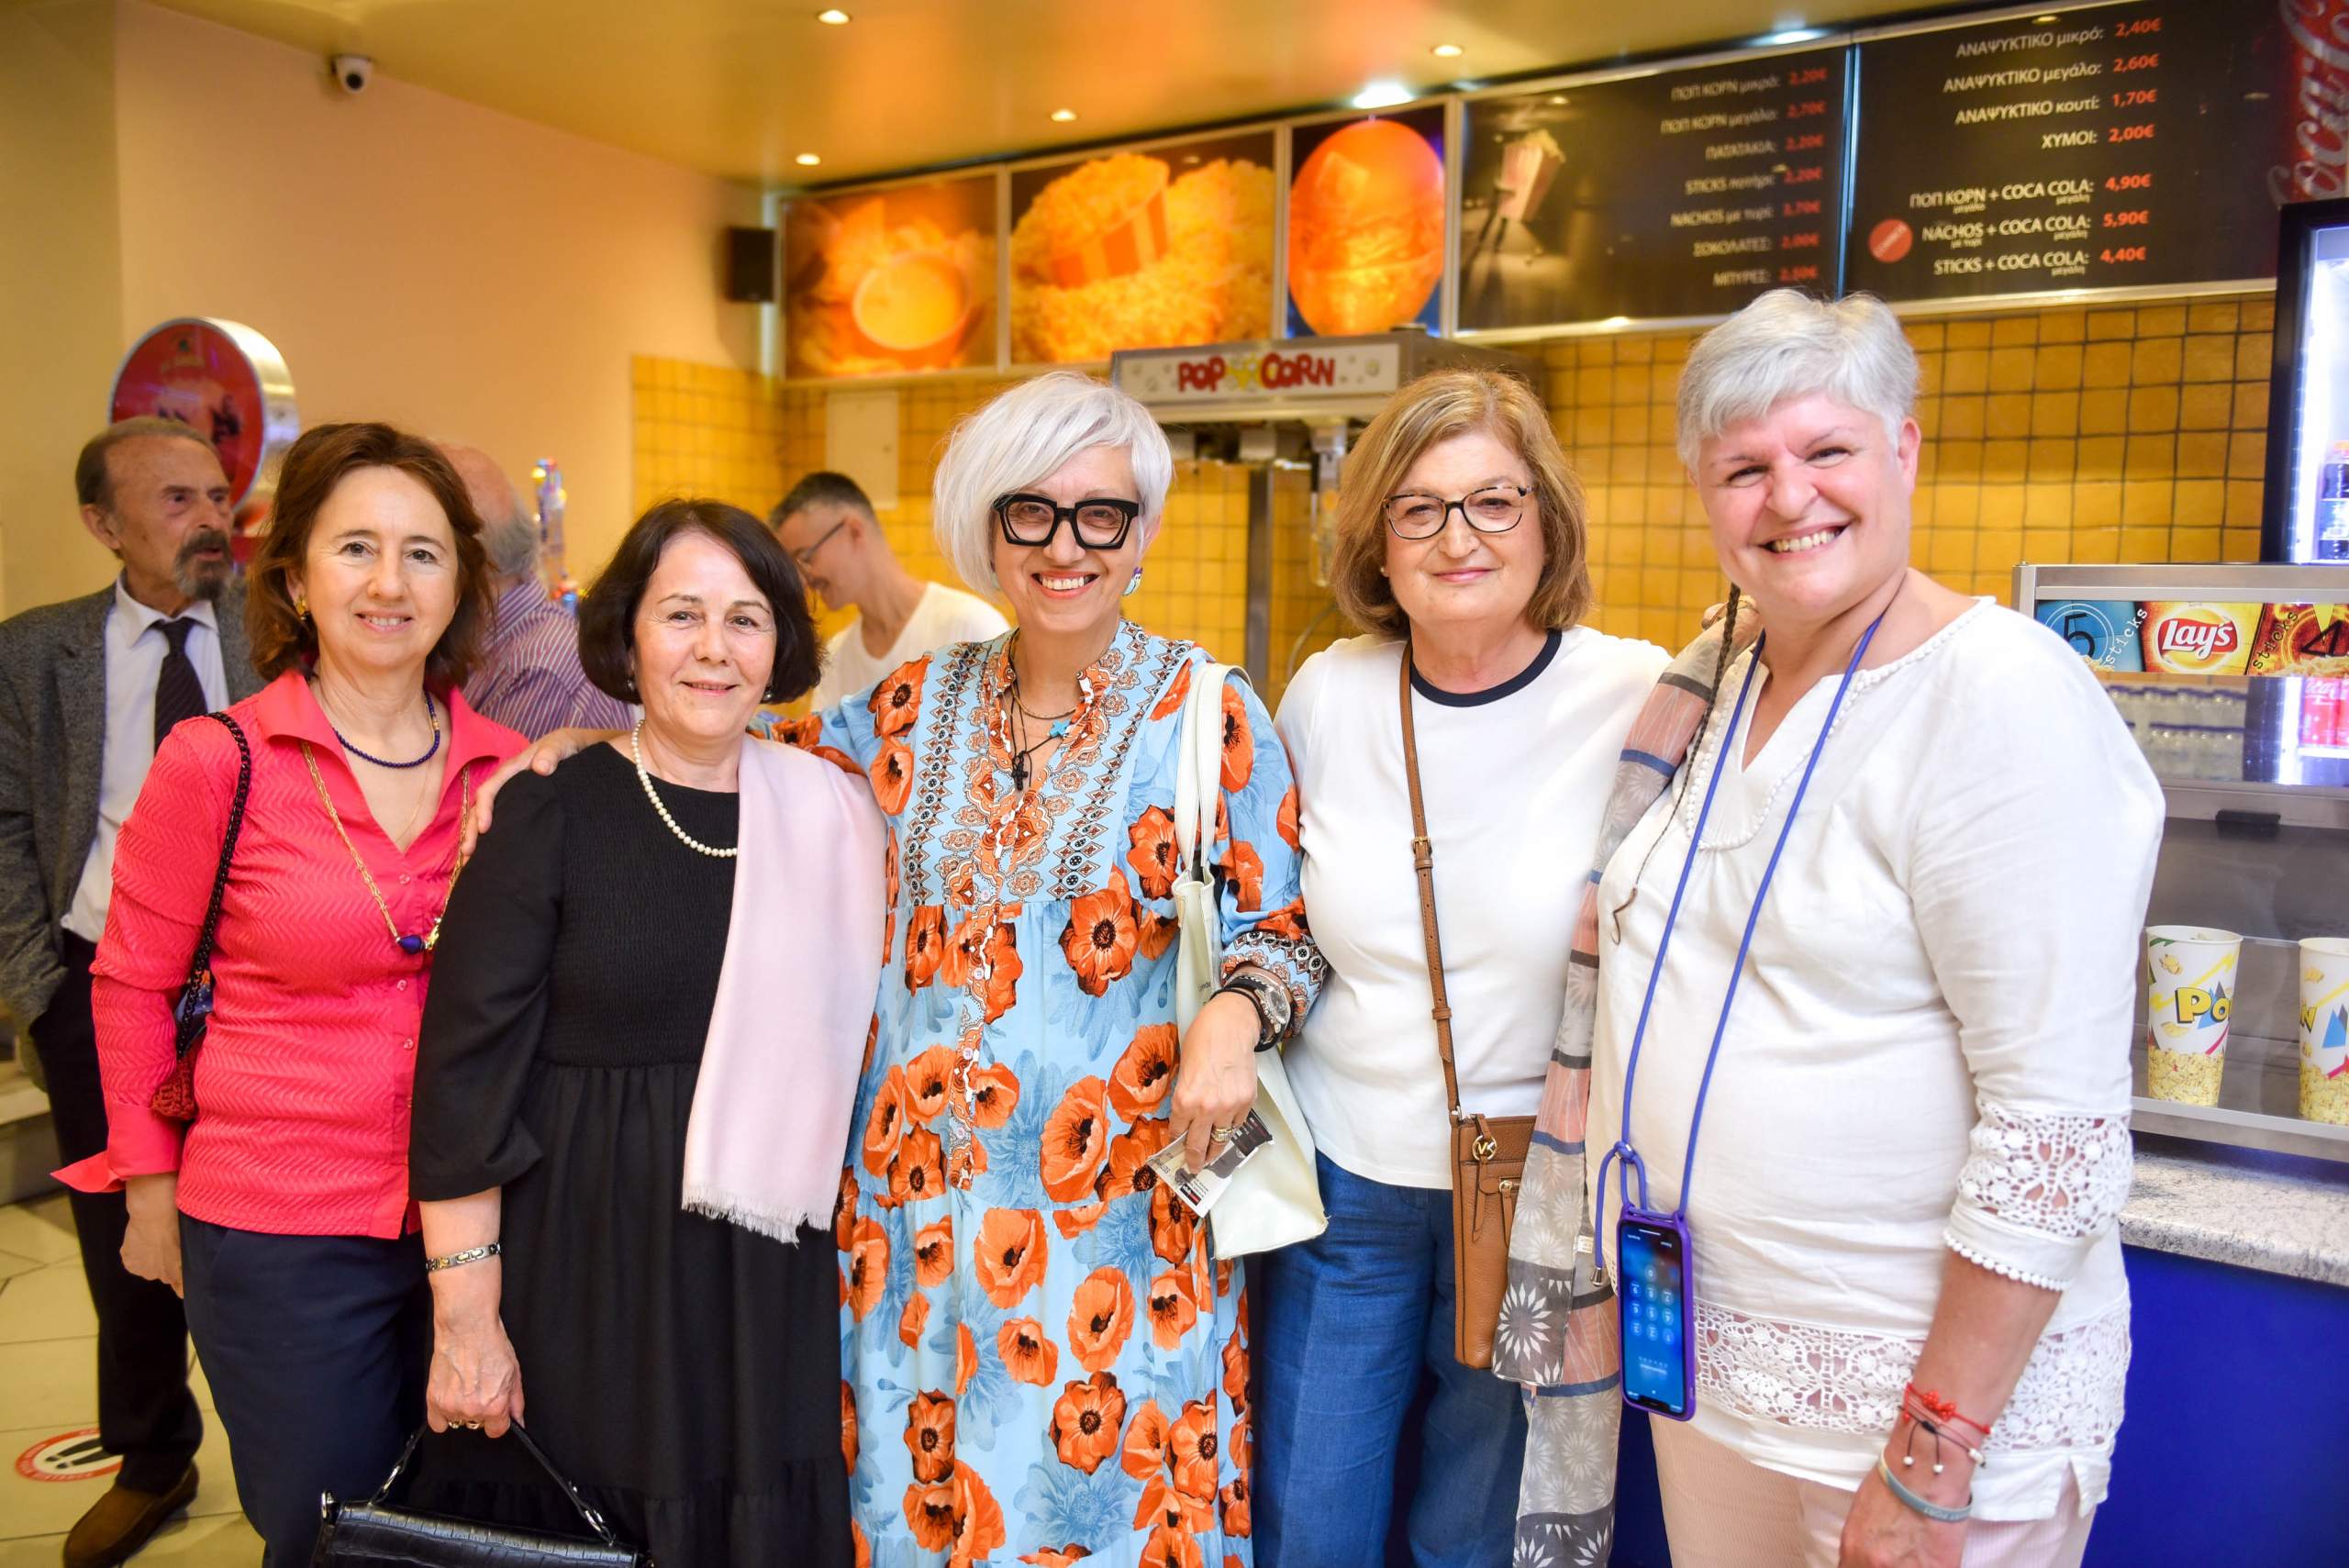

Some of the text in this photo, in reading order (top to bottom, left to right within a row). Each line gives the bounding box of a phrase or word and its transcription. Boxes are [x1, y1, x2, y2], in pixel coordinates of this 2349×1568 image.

[1955, 18, 2162, 58] ΑΝΑΨΥΚΤΙΚΟ μικρό: 2,40€
[1943, 54, 2159, 93] ΑΝΑΨΥΚΤΙΚΟ μεγάλο: 2,60€
[1954, 89, 2156, 125] ΑΝΑΨΥΚΤΙΚΟ κουτί: 1,70€
[2041, 124, 2154, 150] ΧΥΜΟΙ: 2,00€
[1945, 188, 1986, 206] ΚΟΡΝ
[2001, 183, 2043, 200] COCA
[2047, 178, 2094, 195] COLA:
[2105, 173, 2151, 192] 4,90€
[1922, 222, 1984, 240] NACHOS
[1998, 218, 2043, 236] COCA
[2045, 214, 2090, 231] COLA:
[2103, 210, 2149, 228] 5,90€
[1933, 257, 1982, 275] STICKS
[1997, 252, 2041, 271] COCA
[2043, 250, 2089, 267] COLA:
[2100, 246, 2146, 263] 4,40€
[1178, 356, 1226, 392] POP
[2105, 608, 2148, 664] sticks
[2253, 611, 2299, 669] sticks
